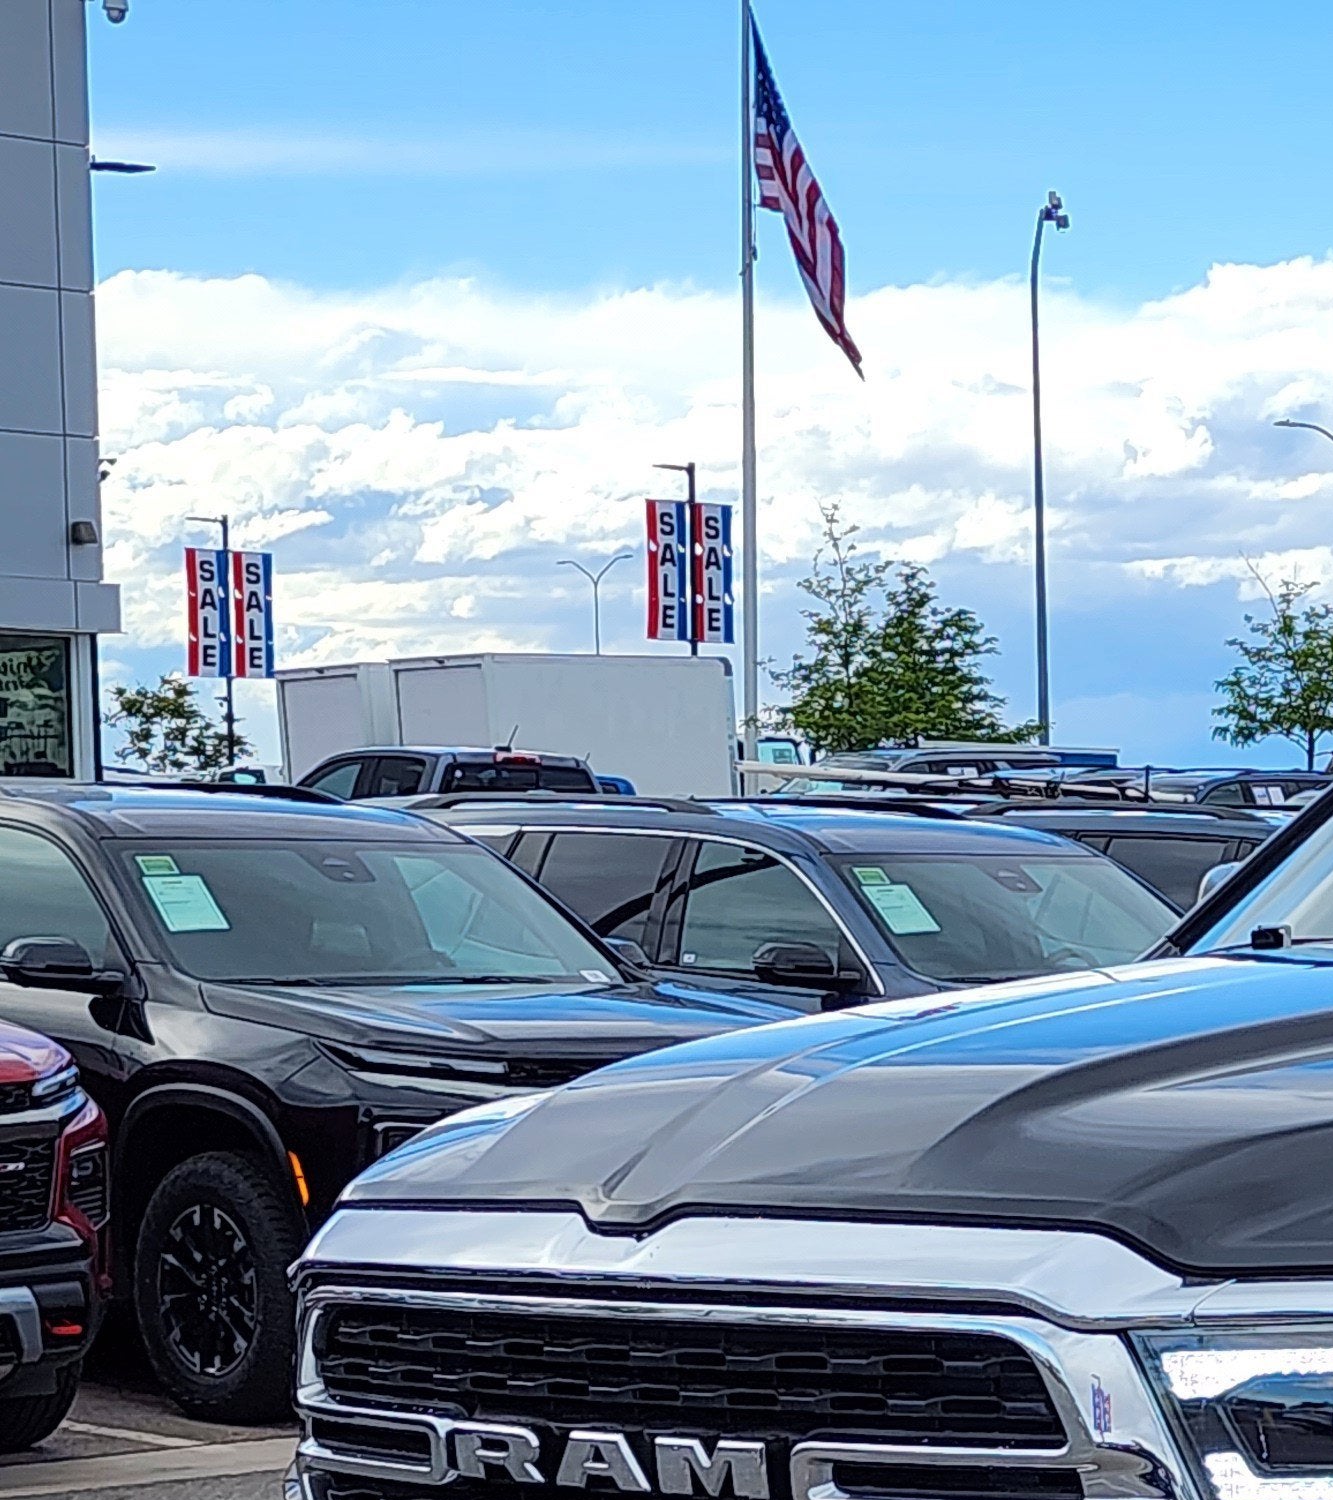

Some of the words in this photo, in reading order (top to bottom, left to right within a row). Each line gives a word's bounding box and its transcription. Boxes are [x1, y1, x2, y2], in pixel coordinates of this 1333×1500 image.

[199, 560, 217, 667] SALE
[245, 562, 263, 669] SALE
[659, 512, 677, 629] SALE
[704, 516, 721, 632] SALE
[454, 1420, 770, 1500] RAM
